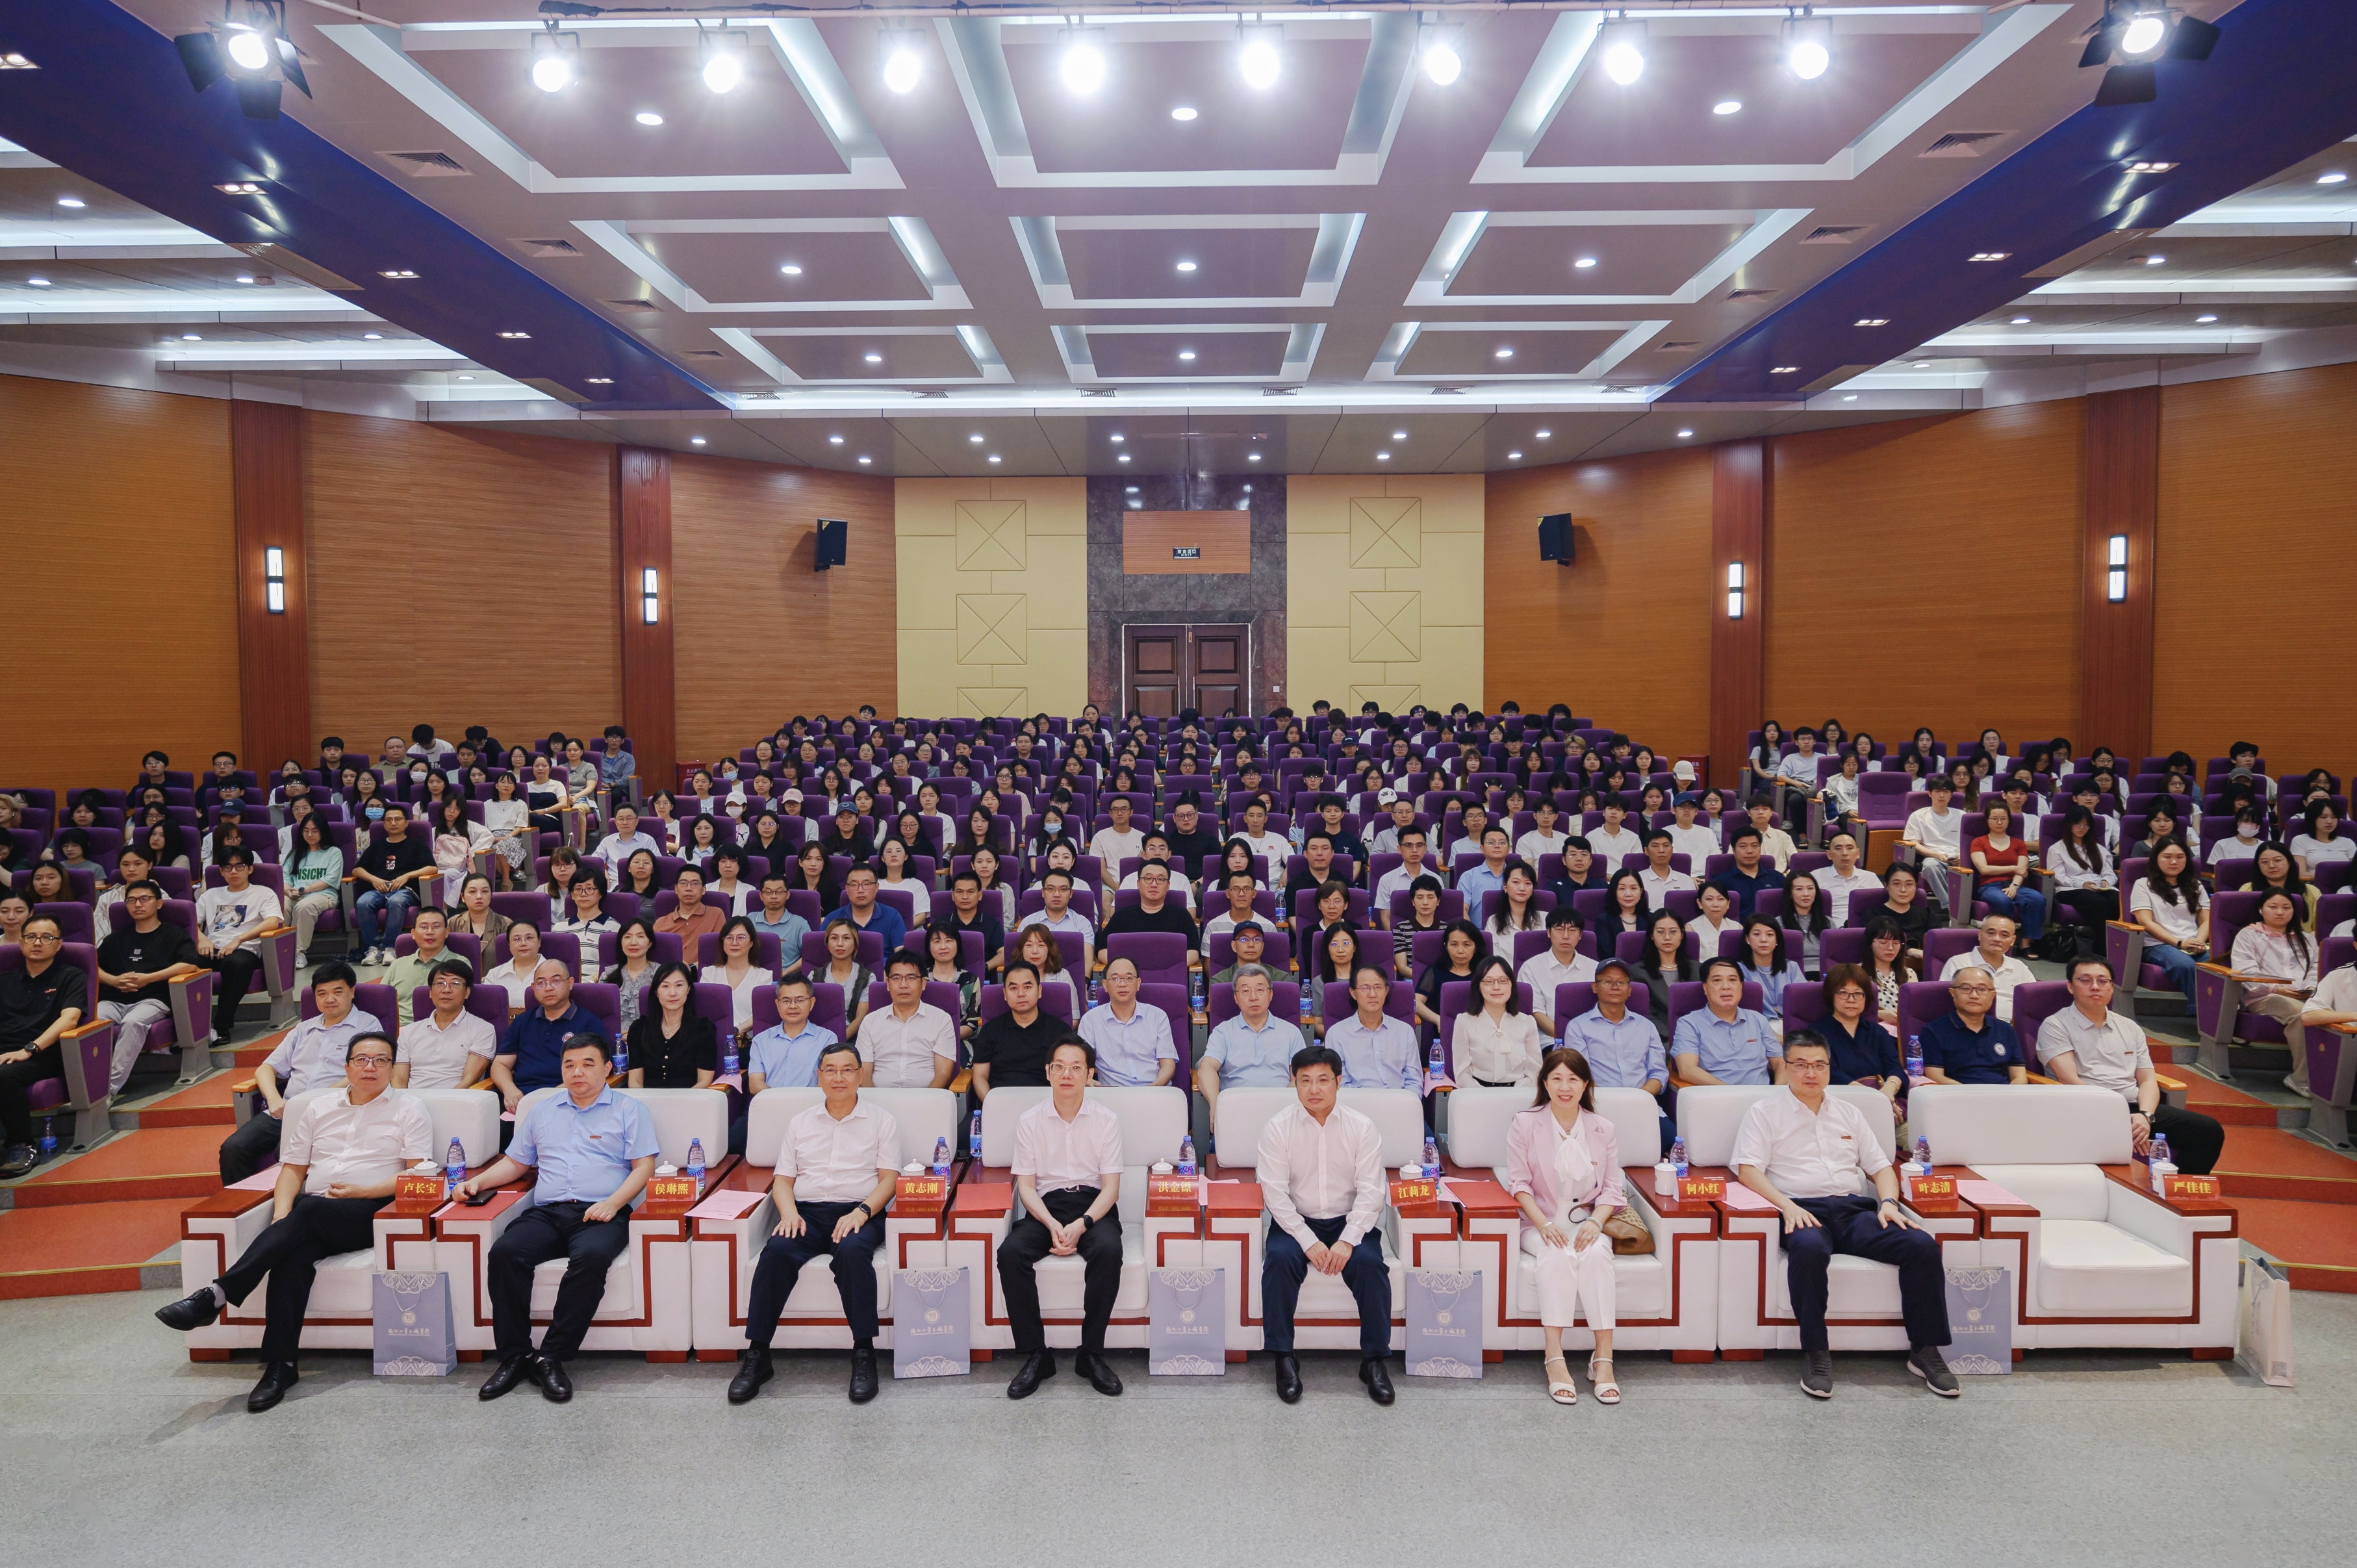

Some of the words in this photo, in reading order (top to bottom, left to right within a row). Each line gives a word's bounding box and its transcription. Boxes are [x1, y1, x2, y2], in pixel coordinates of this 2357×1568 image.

[403, 1182, 437, 1195] 卢长宝
[655, 1183, 689, 1195] 侯琳熙
[904, 1182, 938, 1194] 黄志刚
[1158, 1181, 1191, 1193] 洪金镖
[1398, 1184, 1430, 1199] 江莉龙
[1687, 1183, 1720, 1195] 何小红
[1918, 1181, 1950, 1194] 叶志清
[2173, 1182, 2211, 1194] 严佳佳
